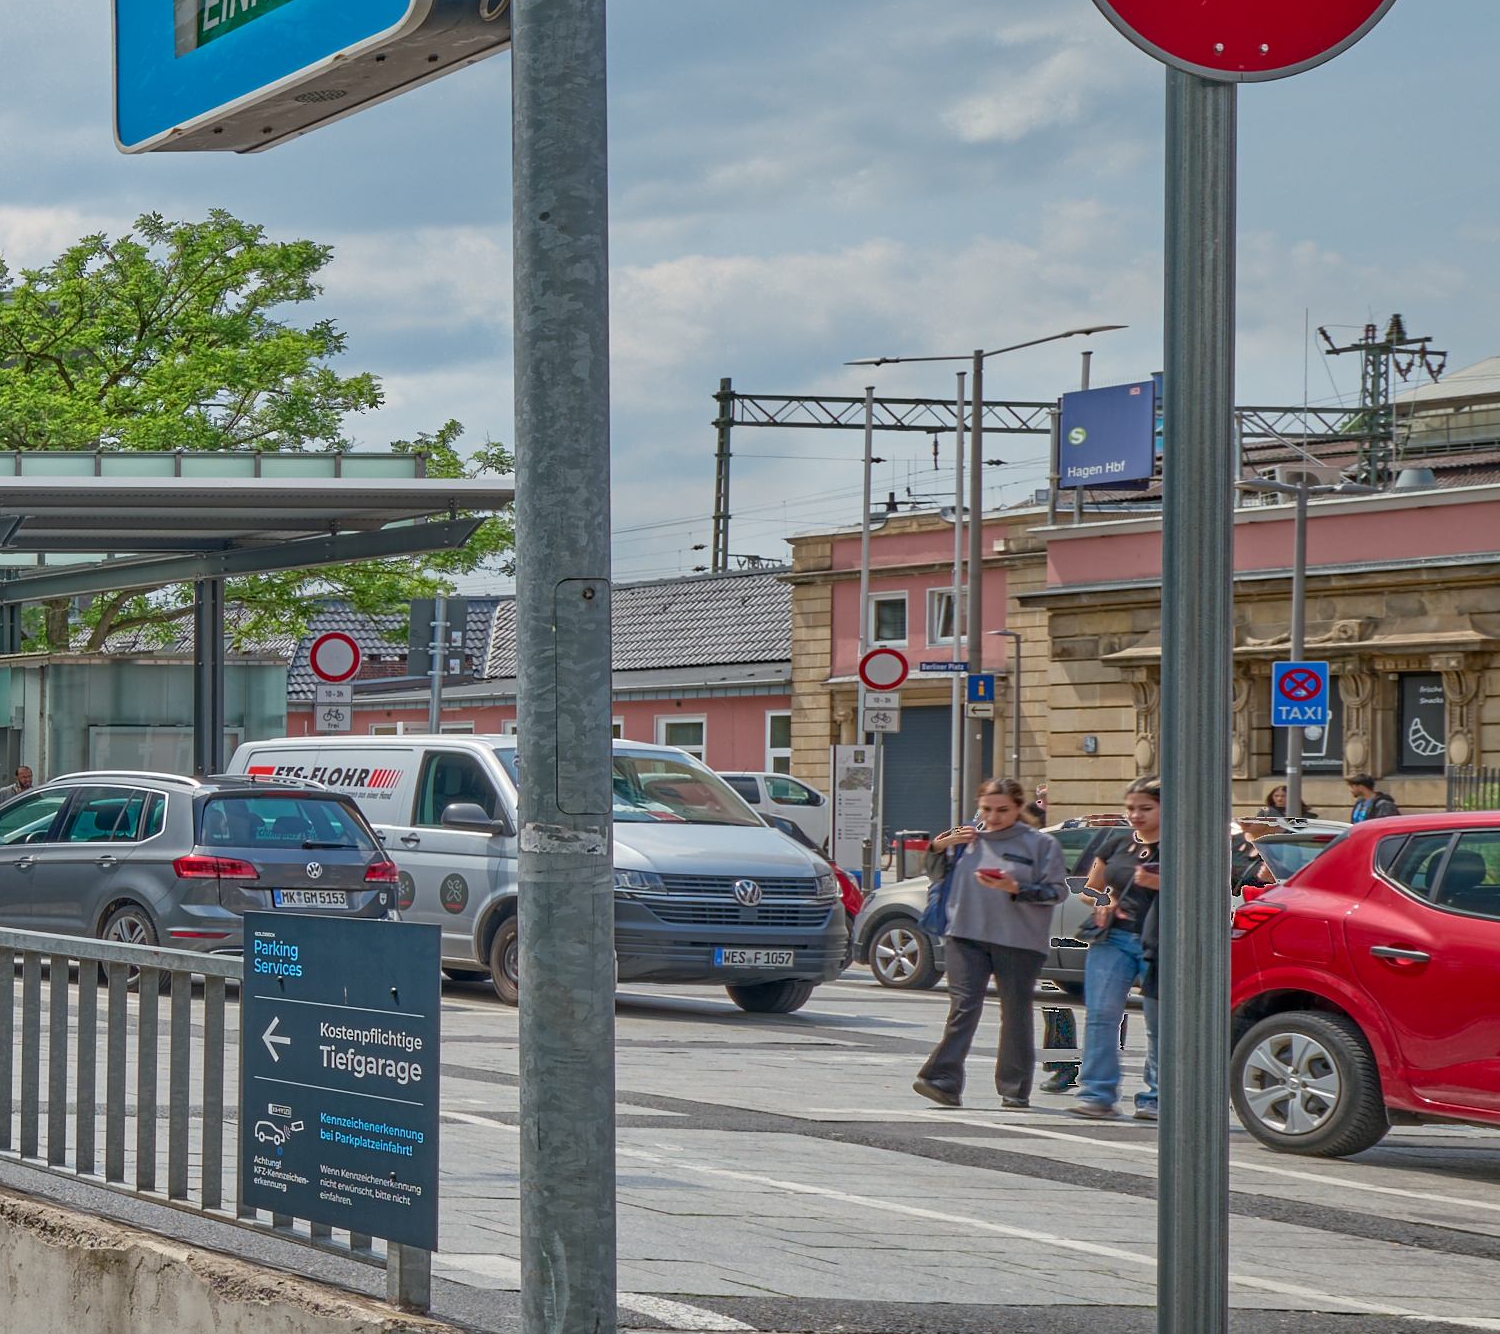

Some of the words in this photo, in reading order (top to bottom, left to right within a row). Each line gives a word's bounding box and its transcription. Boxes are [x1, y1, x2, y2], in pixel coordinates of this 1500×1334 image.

[1067, 465, 1102, 479] Hagen
[1105, 460, 1126, 473] Hbf
[1278, 706, 1322, 720] TAXI
[282, 891, 296, 904] MK
[303, 891, 317, 904] GM
[319, 892, 346, 904] 5153
[254, 939, 298, 961] Parking
[754, 952, 762, 964] F
[764, 952, 792, 965] 1057
[254, 958, 302, 977] Services
[320, 1021, 423, 1052] Kostenpflichtige
[319, 1045, 422, 1085] Tiefgarage
[320, 1112, 424, 1144] Kennzeichenerkennung
[320, 1128, 334, 1141] bei
[335, 1132, 413, 1157] Parkplatzeinfahrt!
[253, 1155, 282, 1169] Achtung!
[253, 1177, 287, 1192] erkennung
[320, 1164, 340, 1176] Wenn
[341, 1169, 422, 1195] Kennzeichenerkennung
[320, 1178, 337, 1189] nicht
[375, 1188, 392, 1201] bitte
[392, 1194, 411, 1206] nicht
[320, 1191, 353, 1206] einfahren.
